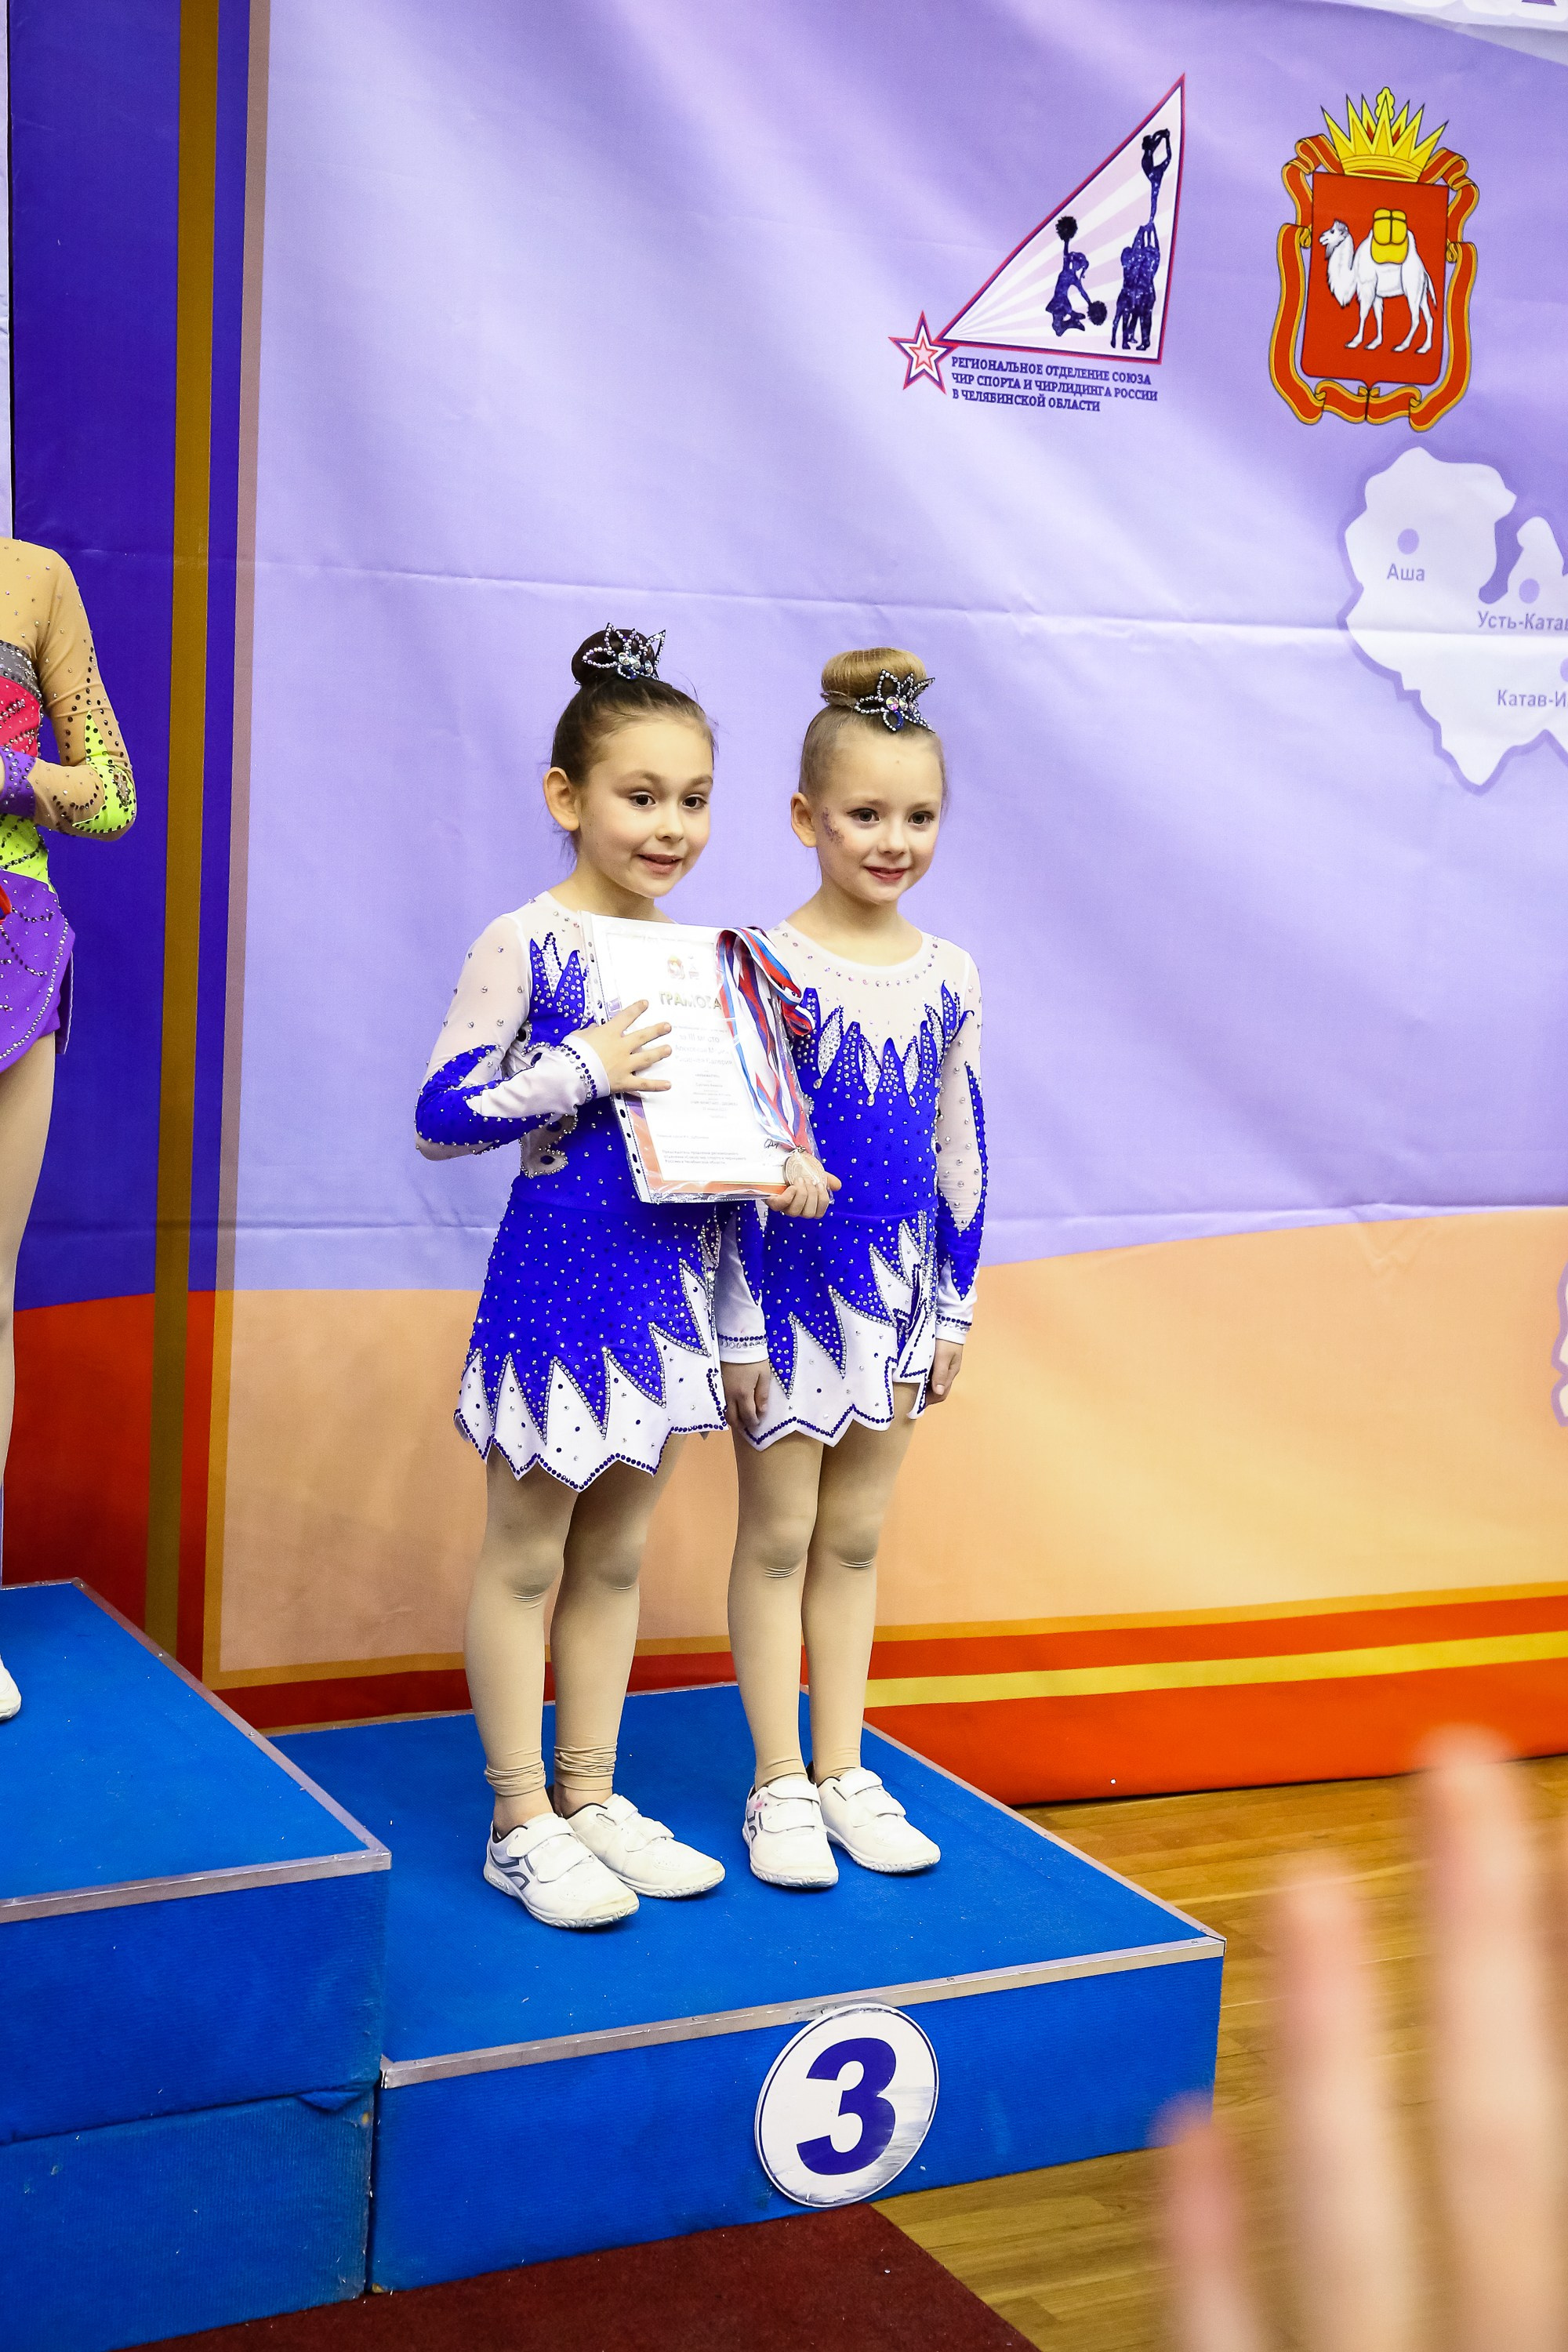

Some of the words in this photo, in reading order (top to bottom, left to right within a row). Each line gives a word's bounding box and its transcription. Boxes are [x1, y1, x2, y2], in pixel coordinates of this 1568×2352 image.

[951, 356, 1044, 375] РЕГИОНАЛЬНОЕ
[1045, 365, 1110, 381] ОТДЕЛЕНИЕ
[1112, 371, 1152, 385] СОЮЗА
[951, 372, 975, 385] ЧИР
[976, 375, 1021, 390] СПОРТА
[1023, 379, 1033, 390] И
[1034, 379, 1112, 397] ЧИРЛИДИНГА
[1114, 387, 1159, 401] РОССИИ
[952, 389, 959, 399] В
[961, 390, 1047, 408] ЧЕЛЯБИНСКОЙ
[1047, 398, 1101, 412] ОБЛАСТИ
[1386, 562, 1425, 582] Аша
[1497, 689, 1568, 707] Катав-И
[796, 2037, 896, 2176] 3
